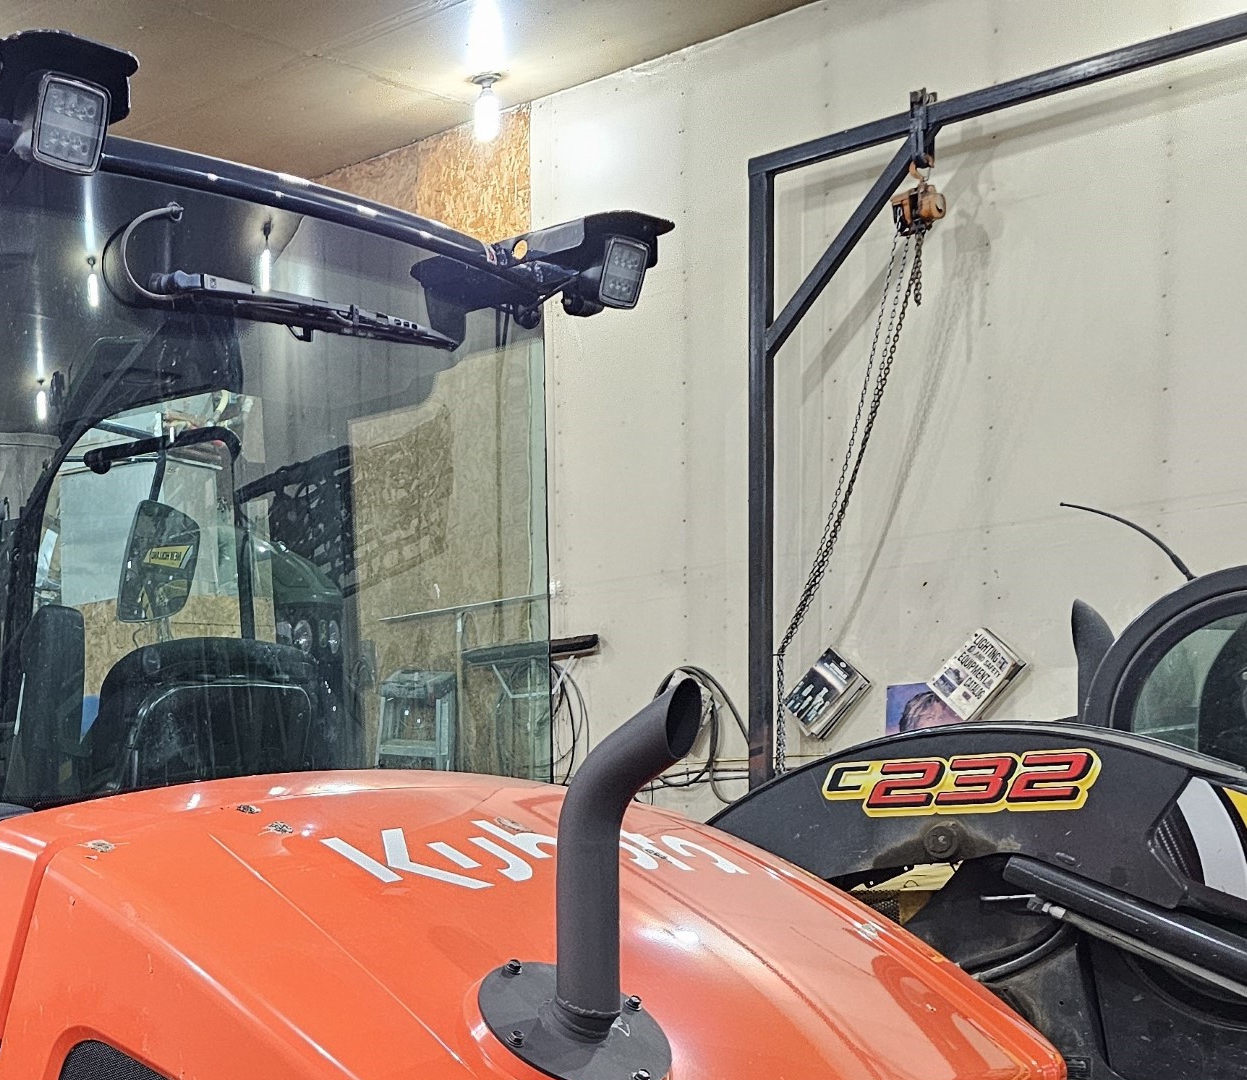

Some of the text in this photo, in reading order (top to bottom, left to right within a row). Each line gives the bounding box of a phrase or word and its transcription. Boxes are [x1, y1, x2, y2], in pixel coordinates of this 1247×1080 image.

[973, 634, 1001, 663] LIGHTING
[957, 651, 991, 685] EQUIPMENT
[983, 659, 1001, 679] SAFETY
[963, 677, 986, 700] CATALOG
